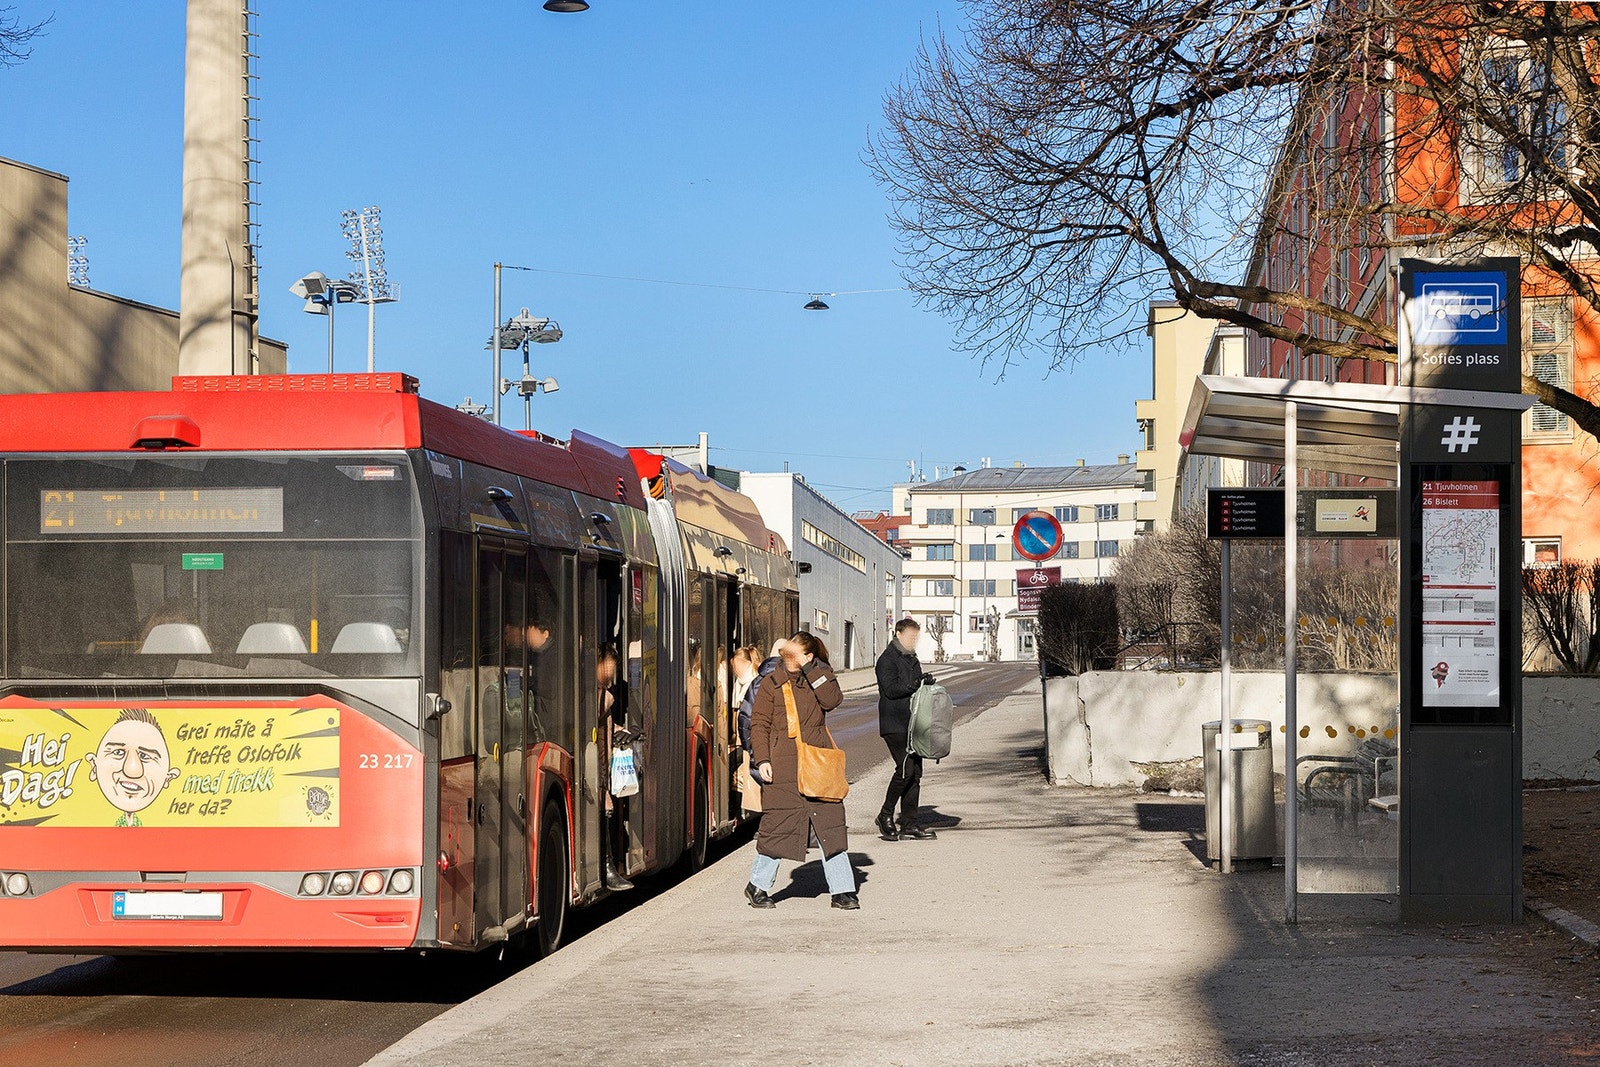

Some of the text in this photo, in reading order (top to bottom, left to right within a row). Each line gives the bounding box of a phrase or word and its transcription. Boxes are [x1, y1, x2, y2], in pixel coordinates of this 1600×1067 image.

[1422, 352, 1500, 367] Sofies plass
[1422, 483, 1479, 492] 21 Tjuvholmen
[1422, 498, 1459, 506] 26 Bislett
[176, 717, 275, 741] Grei måte å
[20, 732, 72, 768] Hei
[184, 743, 302, 765] treffe Oslofolk
[359, 753, 414, 769] 23 217
[0, 758, 83, 809] Dag!
[181, 766, 275, 795] med trøkk
[167, 797, 233, 816] her da?
